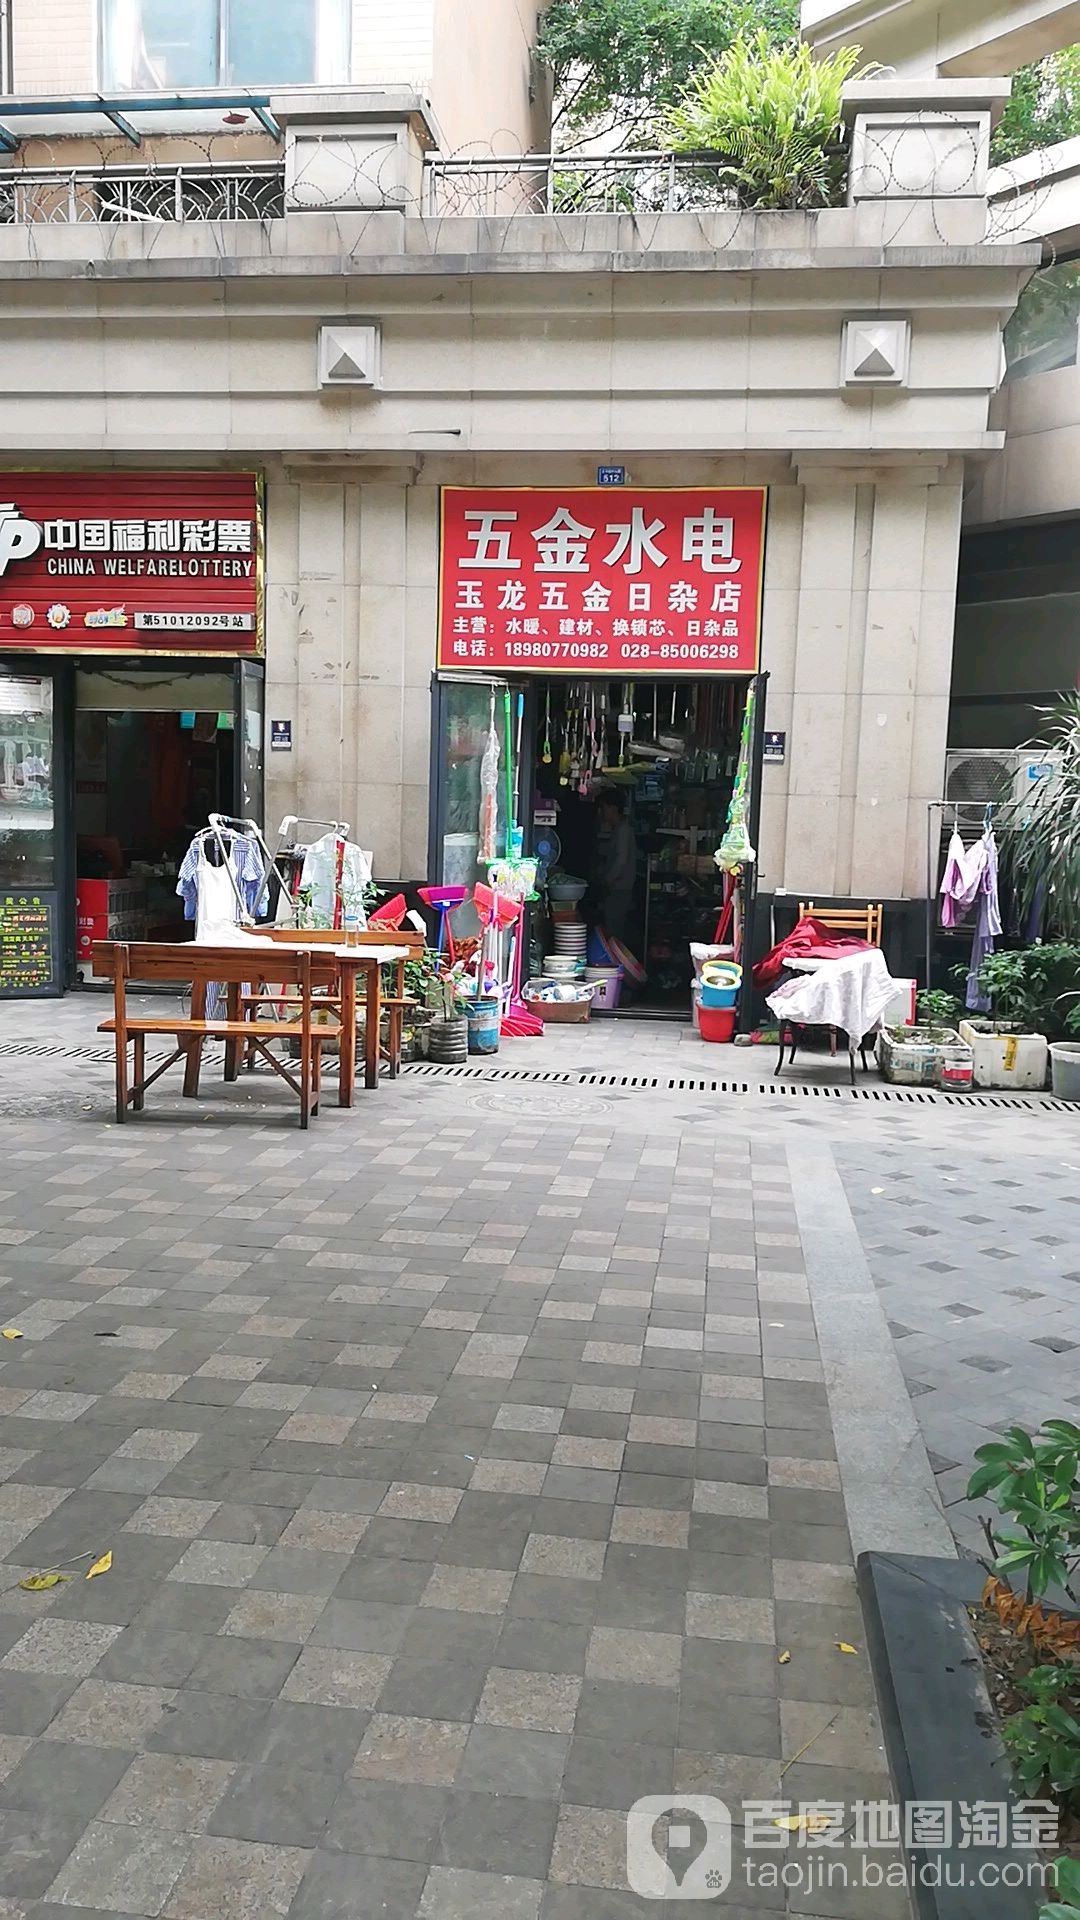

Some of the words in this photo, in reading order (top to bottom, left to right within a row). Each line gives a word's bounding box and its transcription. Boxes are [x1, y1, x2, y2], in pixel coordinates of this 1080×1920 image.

[44, 519, 252, 552] 中国福利彩票
[458, 507, 742, 575] 五金水电
[47, 558, 96, 576] CHINA
[103, 558, 253, 577] WELFARELOTTERY
[455, 579, 742, 613] 玉龙五金日杂店
[142, 614, 243, 628] 第51012092号站
[620, 643, 739, 659] 028-85006298
